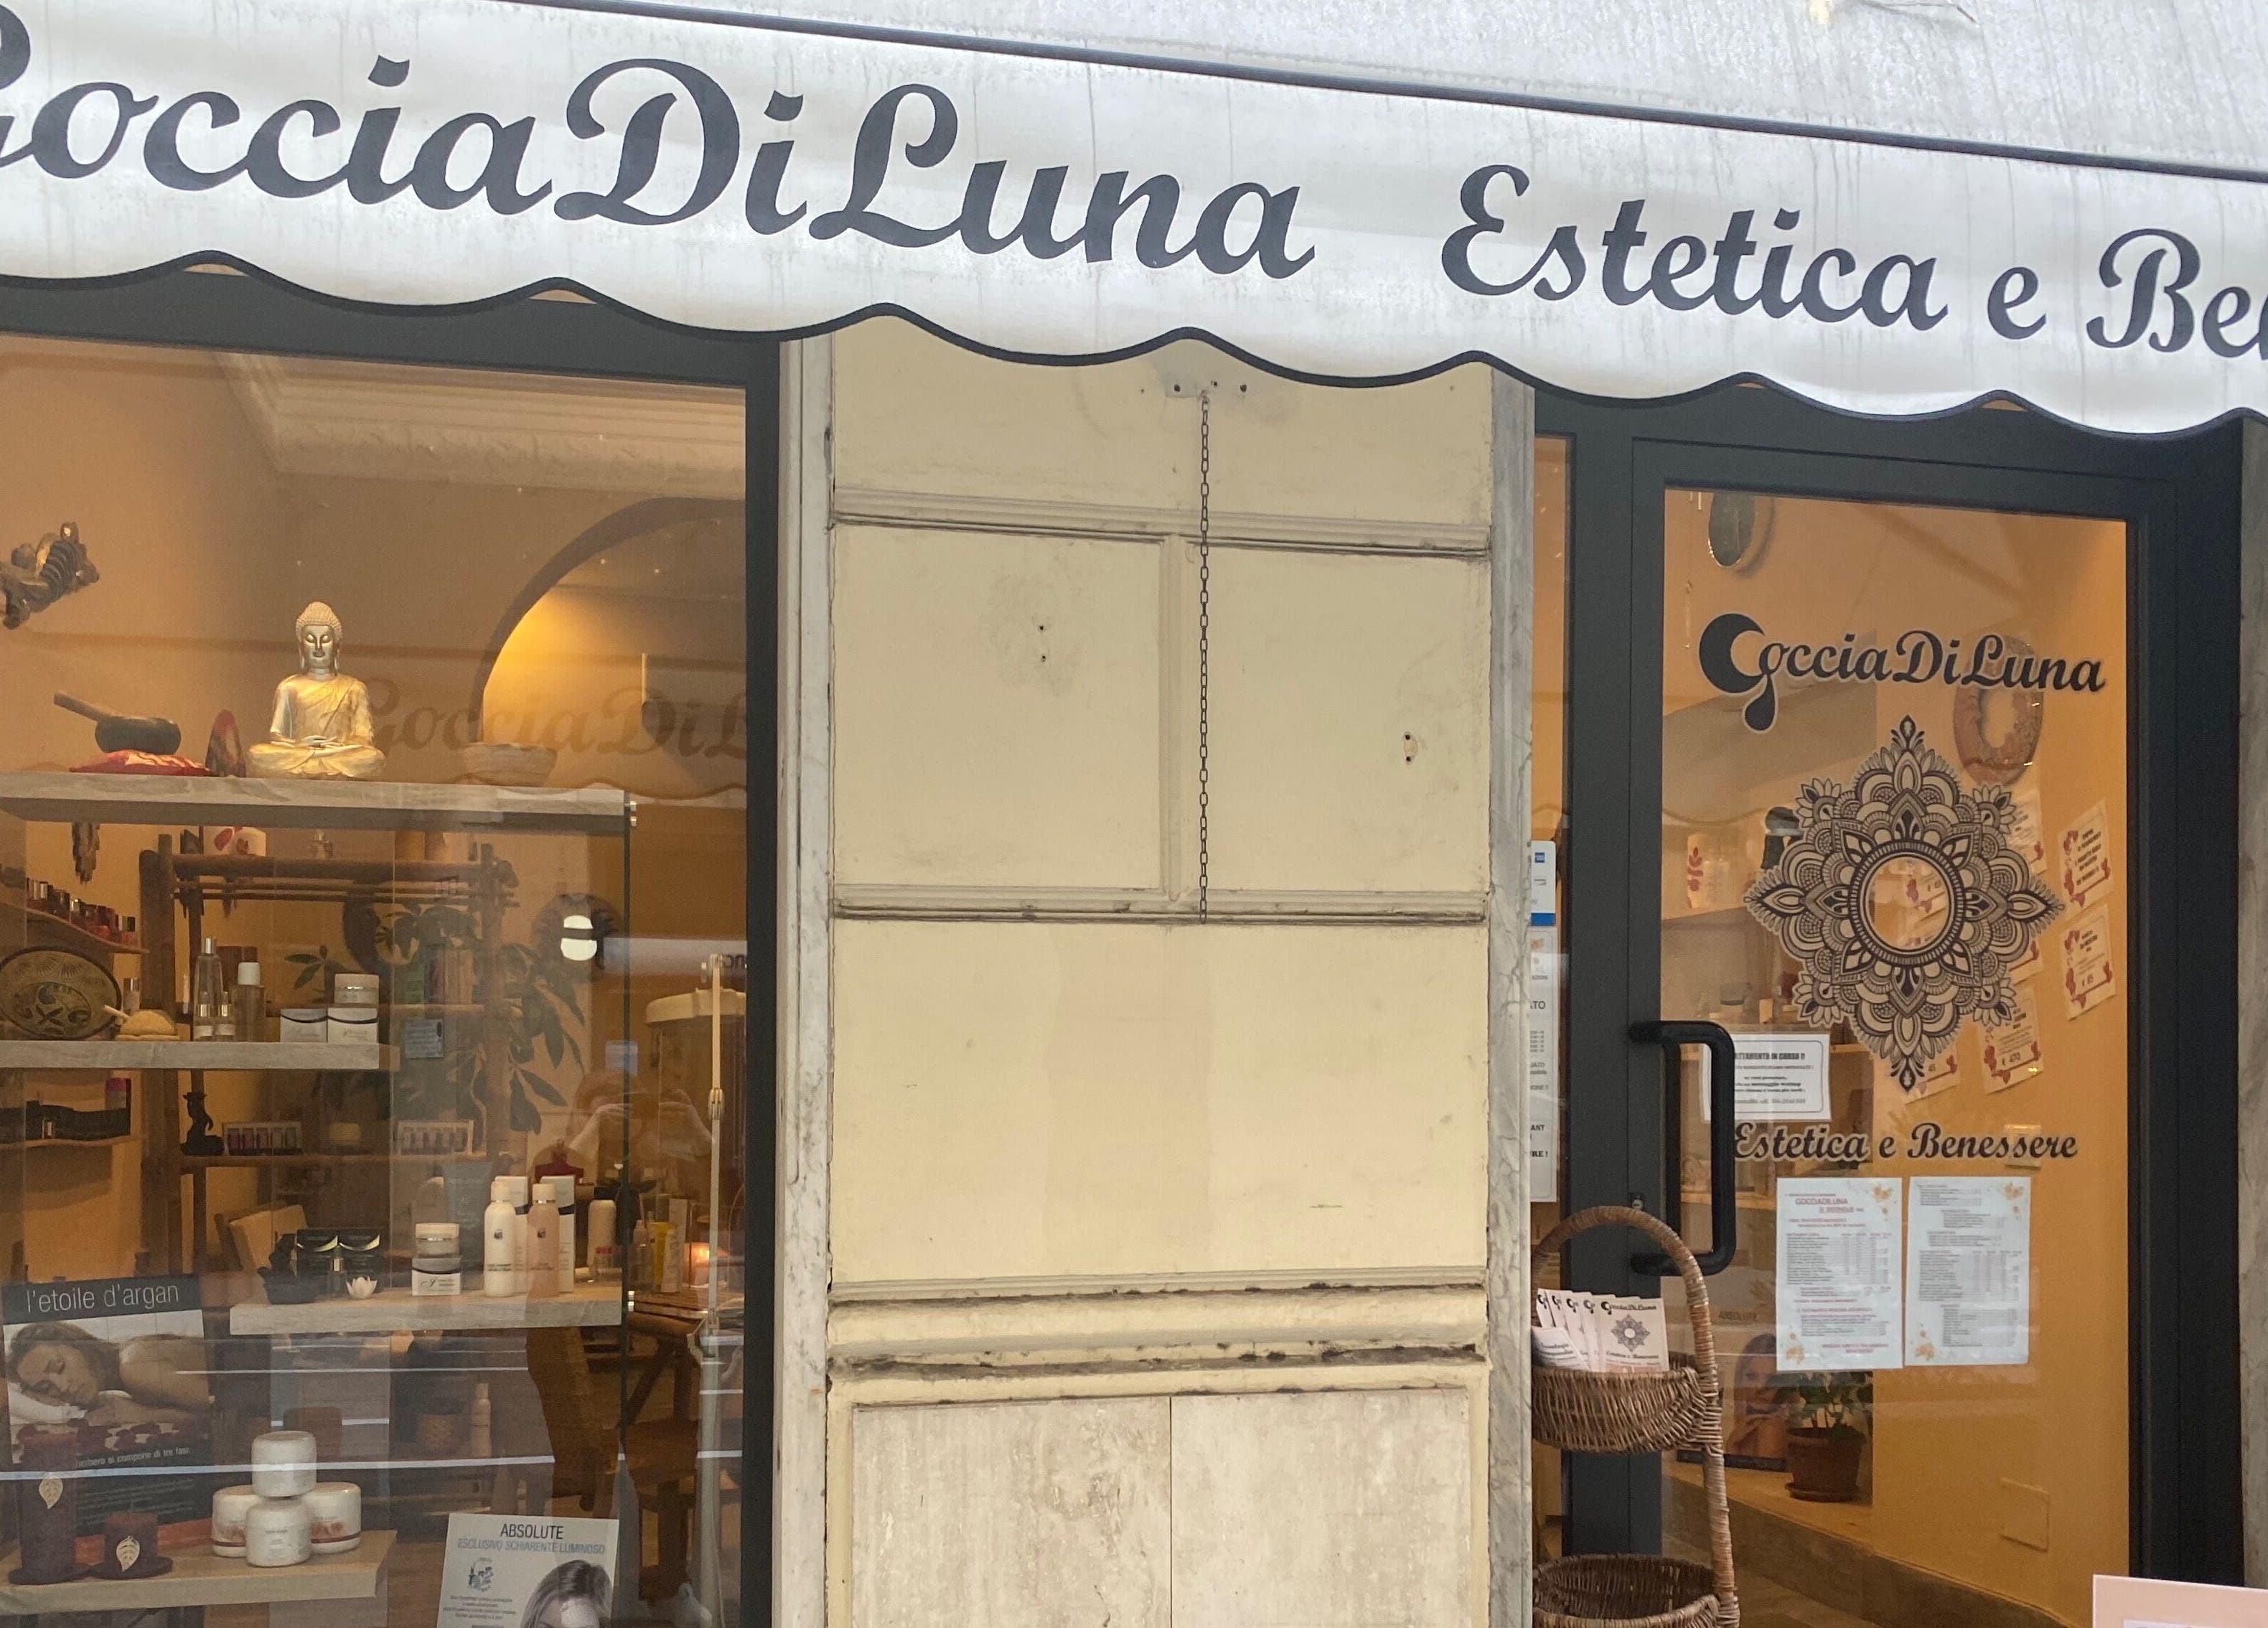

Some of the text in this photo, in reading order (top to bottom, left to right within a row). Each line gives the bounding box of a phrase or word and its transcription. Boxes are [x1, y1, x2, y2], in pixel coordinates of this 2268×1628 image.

[1441, 164, 1948, 331] Estetica
[1987, 266, 2046, 340] e
[2086, 228, 2268, 360] Be
[1733, 1121, 2079, 1159] Estetica e Benessere
[27, 1283, 179, 1313] l'etoile d'argan
[117, 1451, 151, 1464] compone
[500, 1523, 565, 1540] ABSOLUTE
[457, 1538, 606, 1556] ESCLUSIVO SCHIARENTE LUMINOSO
